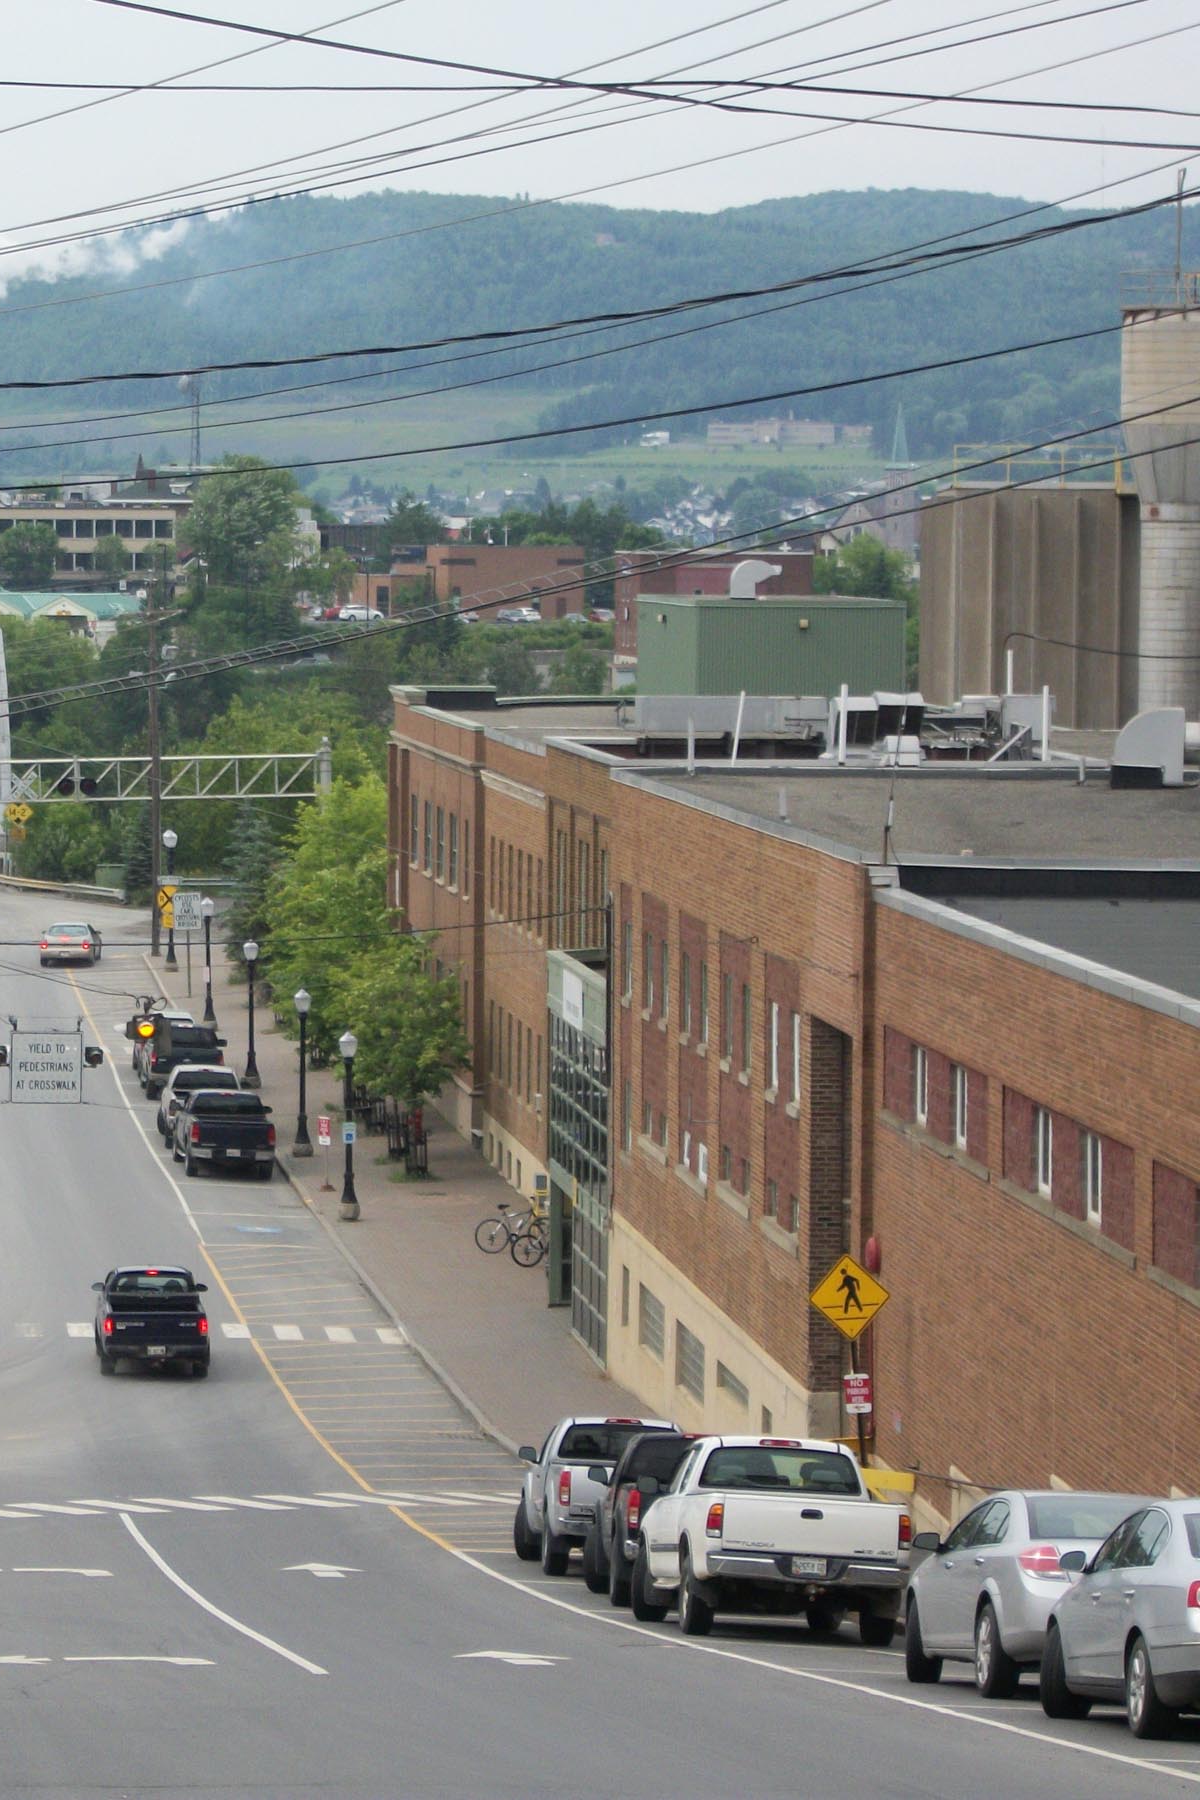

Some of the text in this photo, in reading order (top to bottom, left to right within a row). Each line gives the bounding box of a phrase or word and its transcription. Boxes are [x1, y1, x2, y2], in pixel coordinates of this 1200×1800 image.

[28, 1043, 66, 1054] YIELD TO
[19, 1062, 74, 1072] PEDESTRIANS
[16, 1080, 77, 1090] AT CROSSWALK
